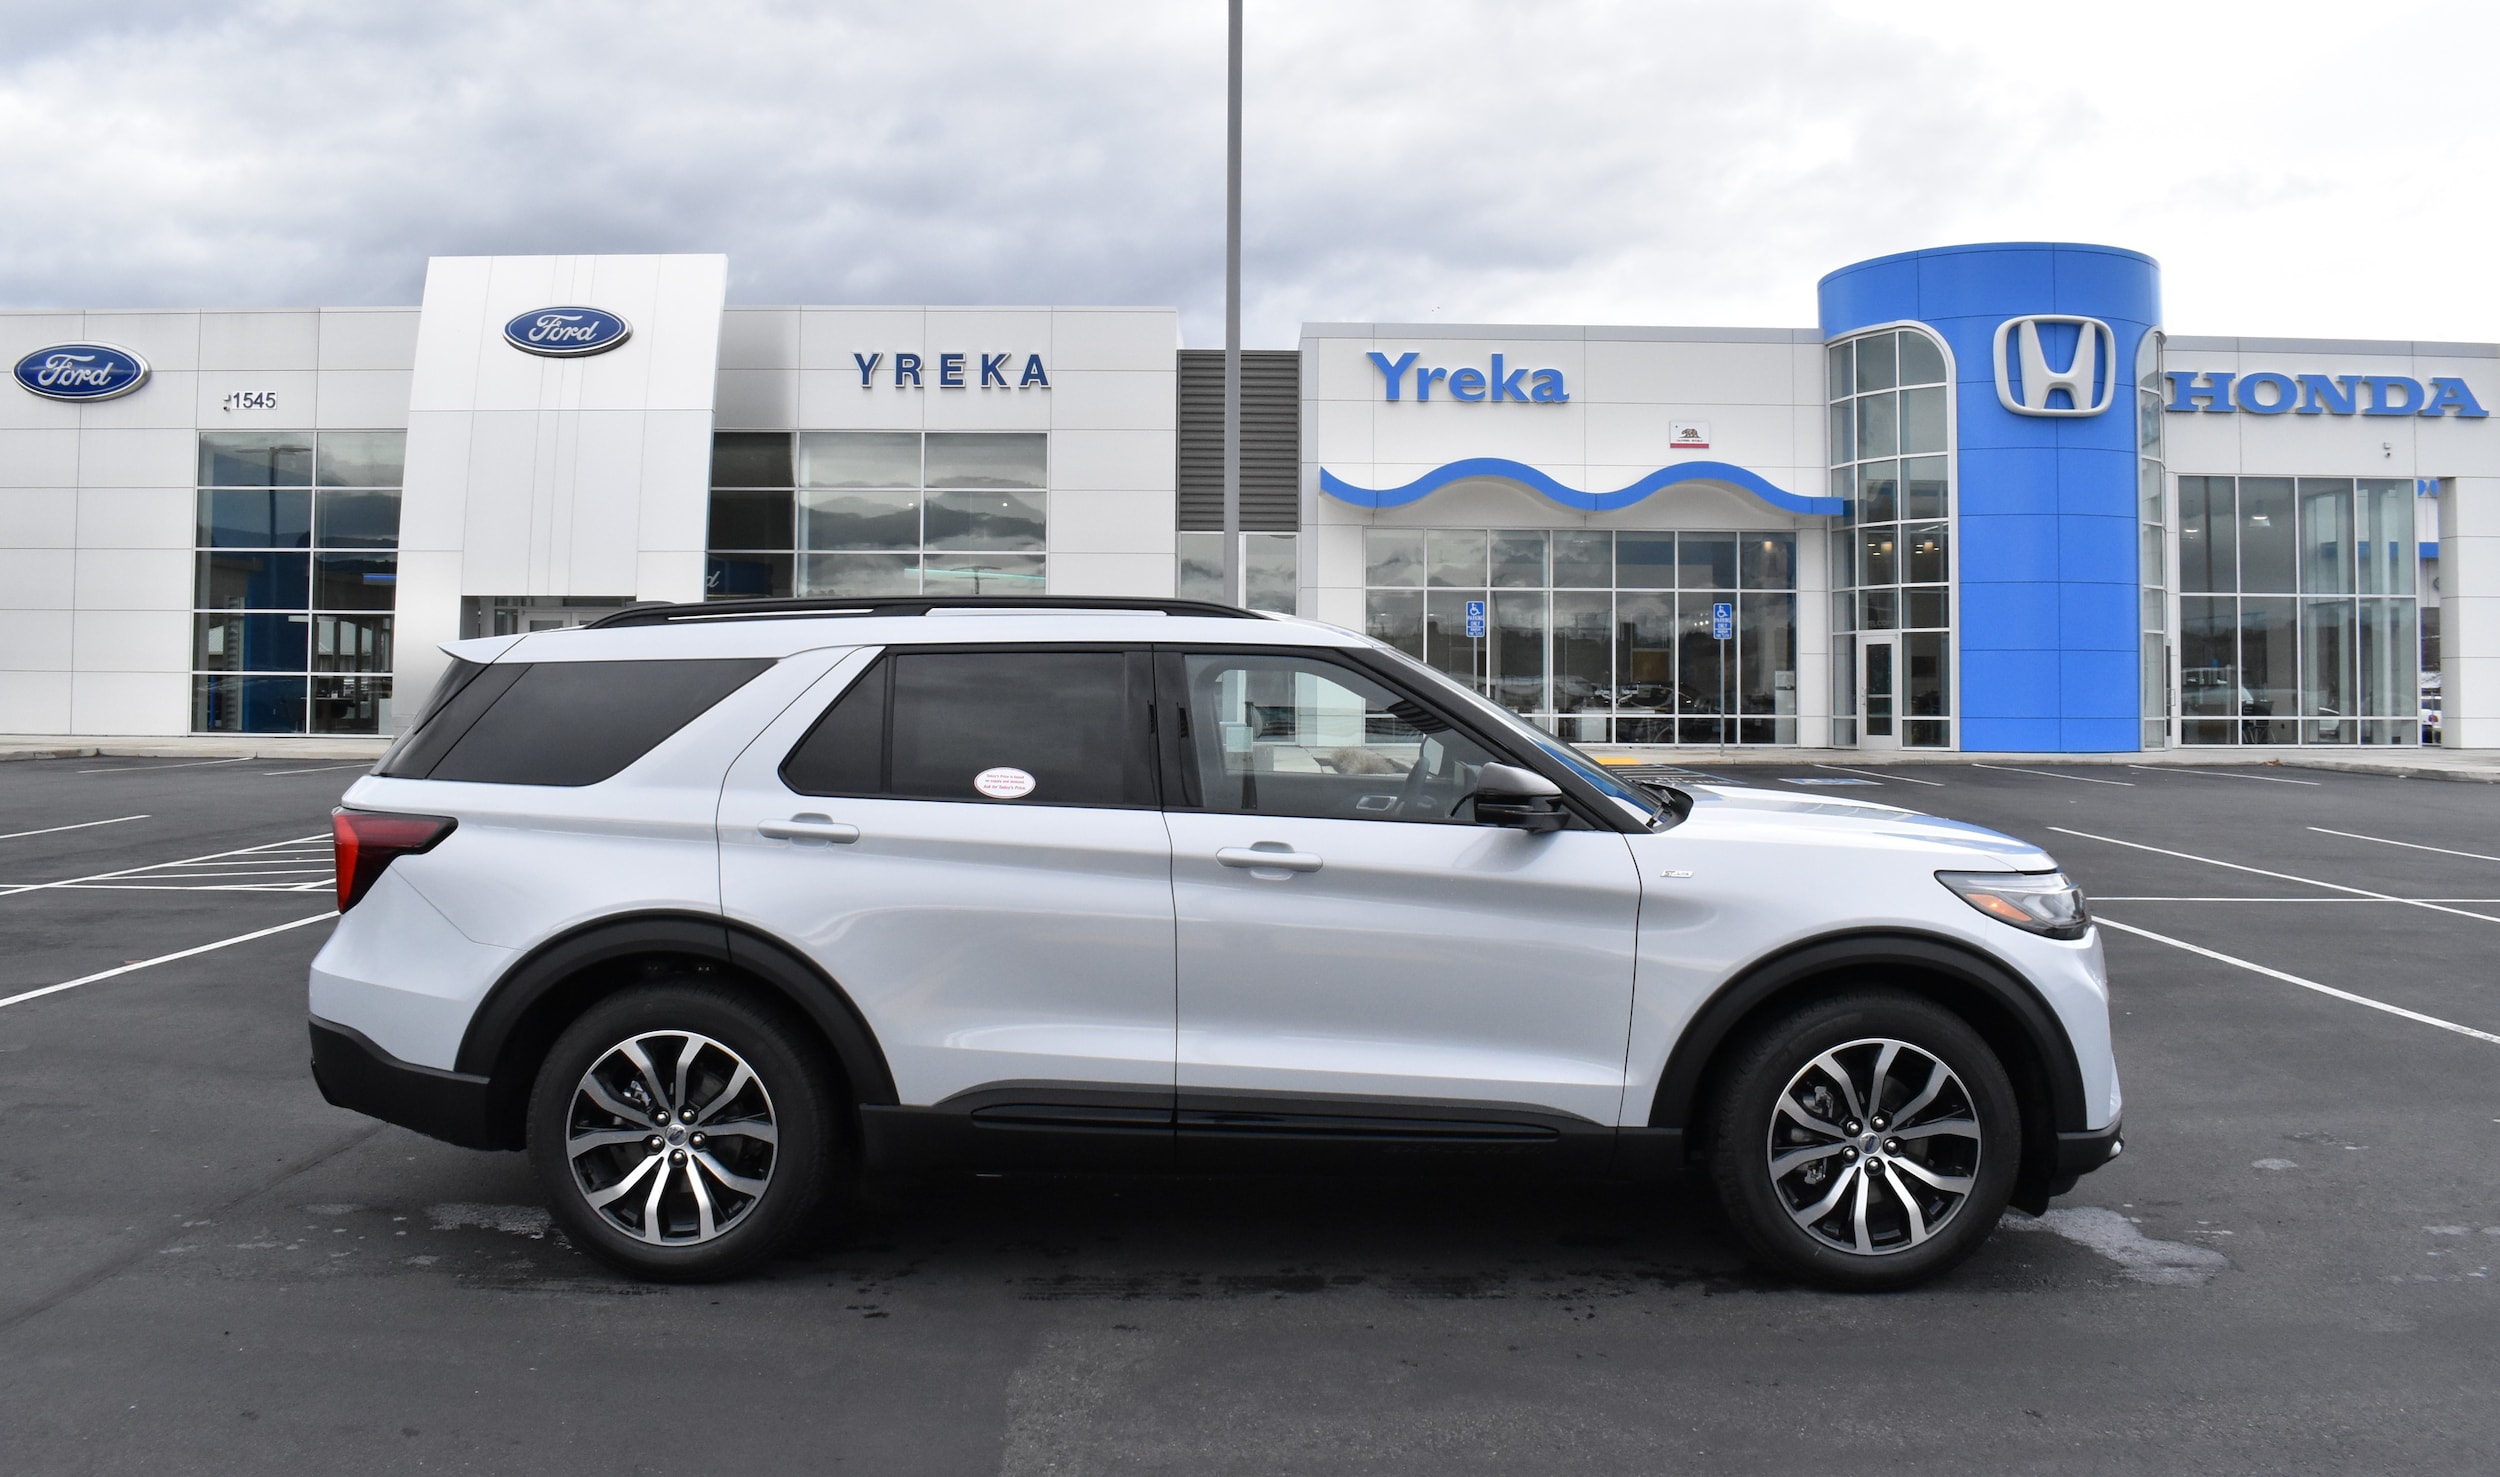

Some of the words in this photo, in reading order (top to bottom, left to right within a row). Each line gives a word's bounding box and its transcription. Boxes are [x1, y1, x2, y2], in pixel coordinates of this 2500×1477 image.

[528, 314, 600, 342] Ford
[37, 353, 115, 386] Ford
[852, 352, 1052, 389] YREKA
[1366, 351, 1570, 404] Yreka
[233, 391, 276, 409] 1545
[2165, 370, 2490, 417] HONDA
